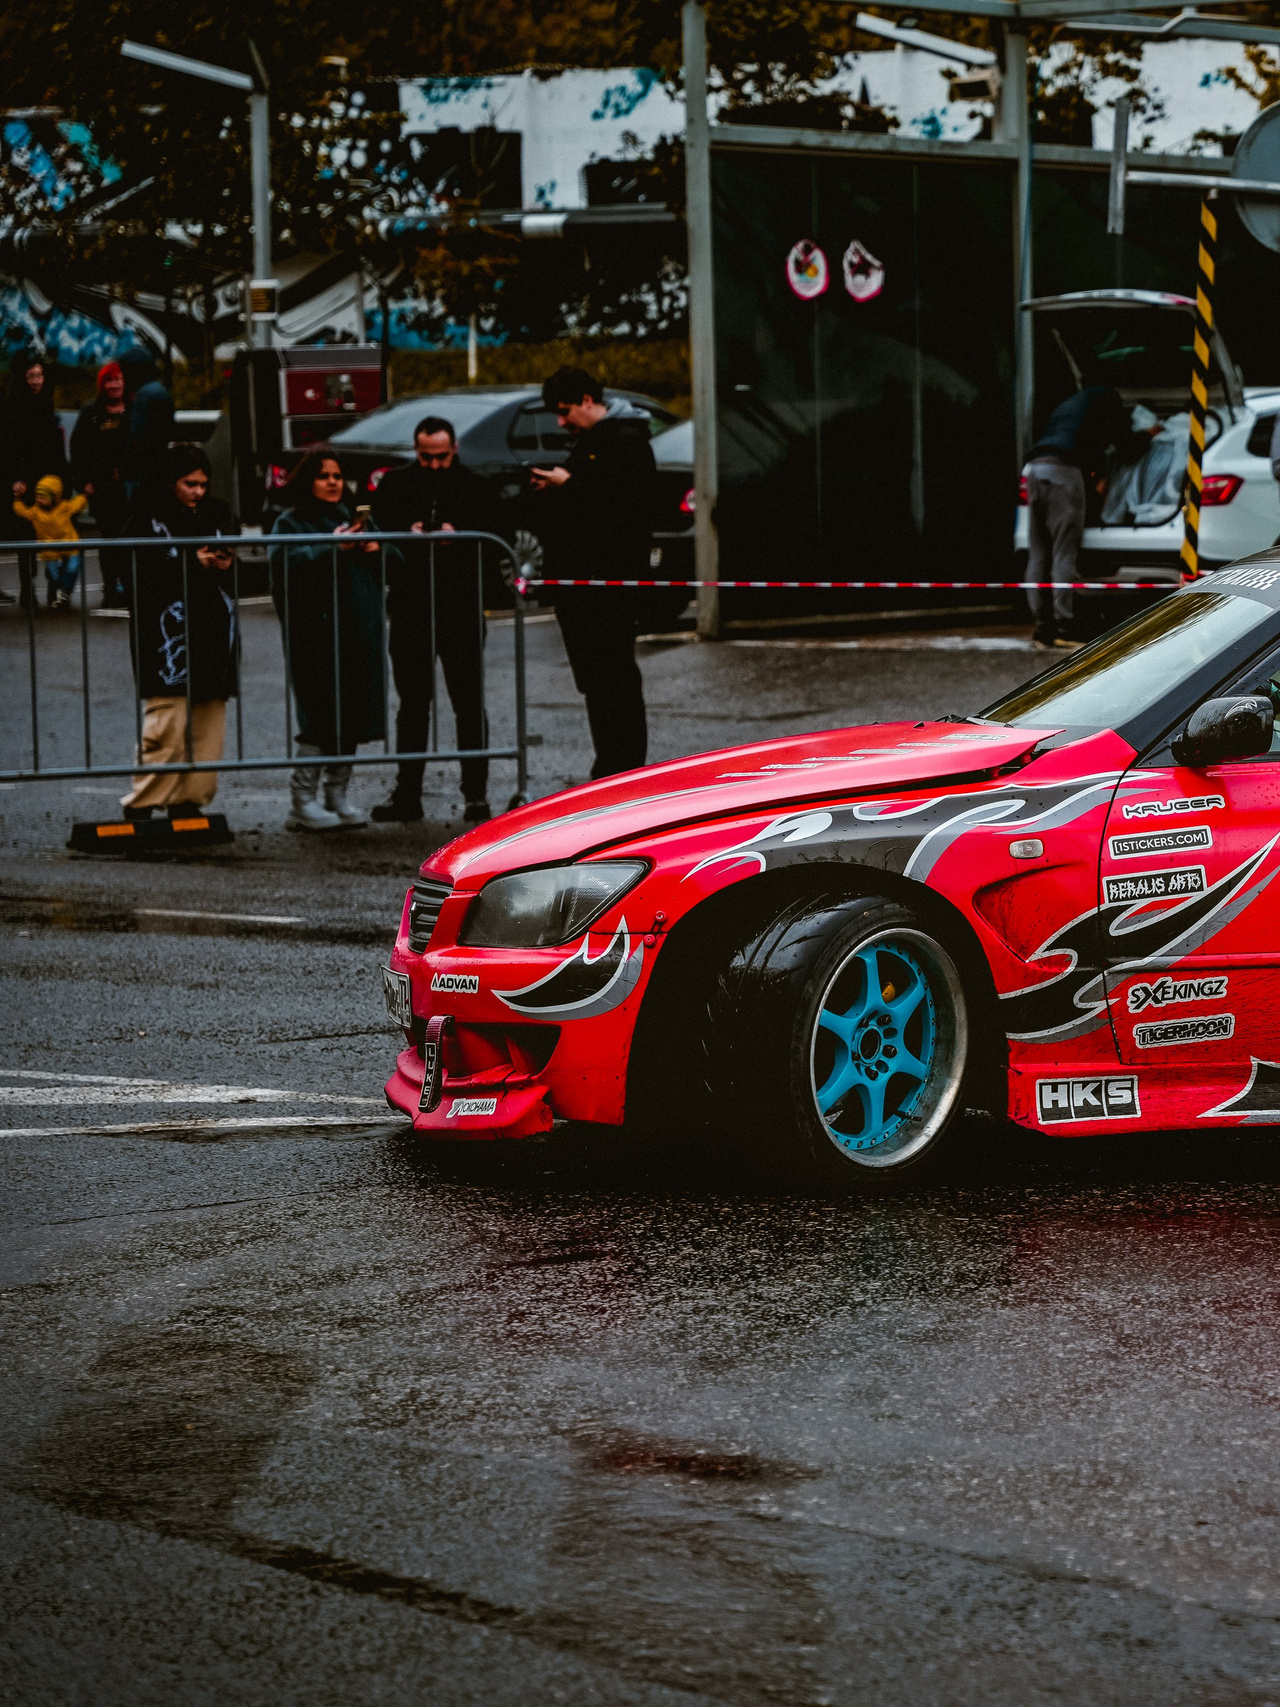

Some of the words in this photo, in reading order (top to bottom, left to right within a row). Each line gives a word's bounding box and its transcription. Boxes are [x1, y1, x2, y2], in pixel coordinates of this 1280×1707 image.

[1125, 797, 1223, 816] KRUGER
[439, 977, 477, 990] ADVAN
[1130, 979, 1226, 1010] SXEKINGZ
[1138, 1017, 1231, 1044] TIGERMOON
[1041, 1081, 1134, 1109] HKS
